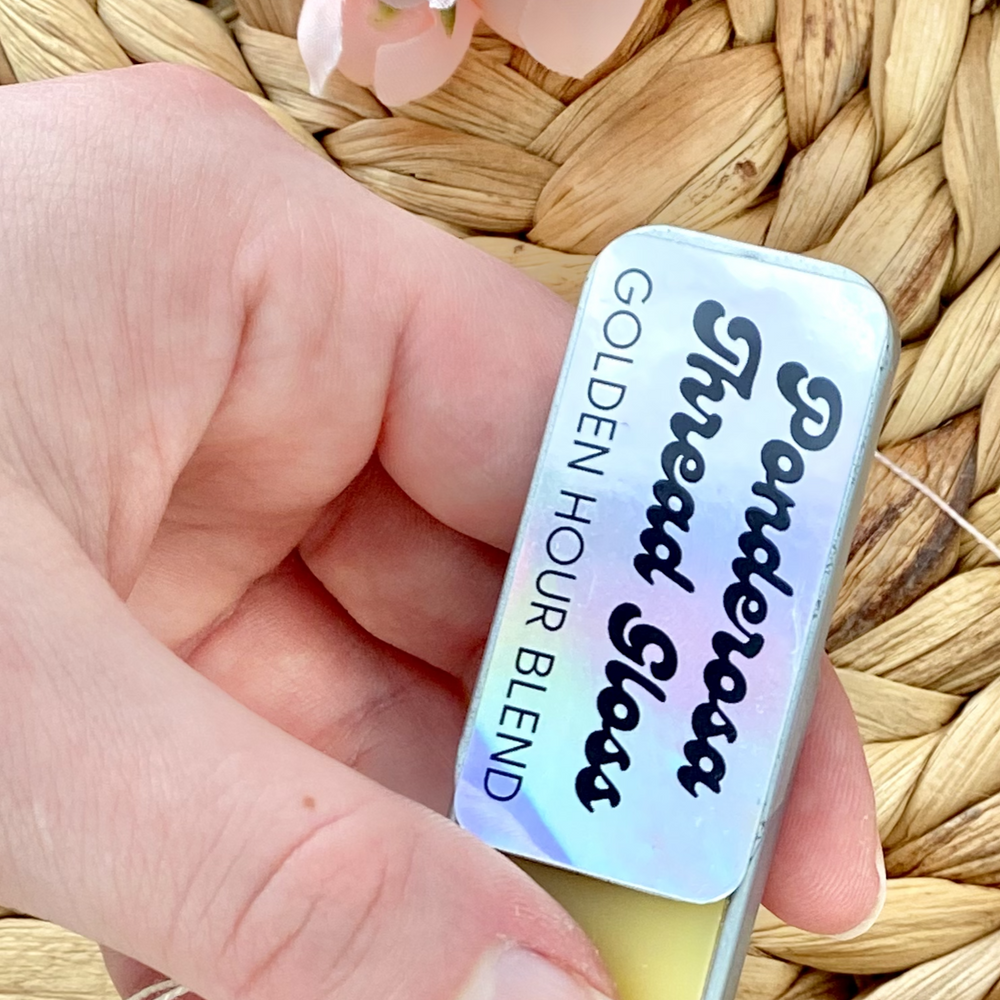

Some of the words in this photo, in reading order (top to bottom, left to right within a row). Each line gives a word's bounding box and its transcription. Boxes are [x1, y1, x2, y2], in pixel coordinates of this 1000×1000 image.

[567, 267, 653, 477] GOLDEN
[633, 298, 763, 594] Thread
[525, 492, 597, 633] HOUR
[677, 361, 843, 798] Ponderosa
[483, 645, 556, 803] BLEND
[574, 602, 679, 812] Gloss
